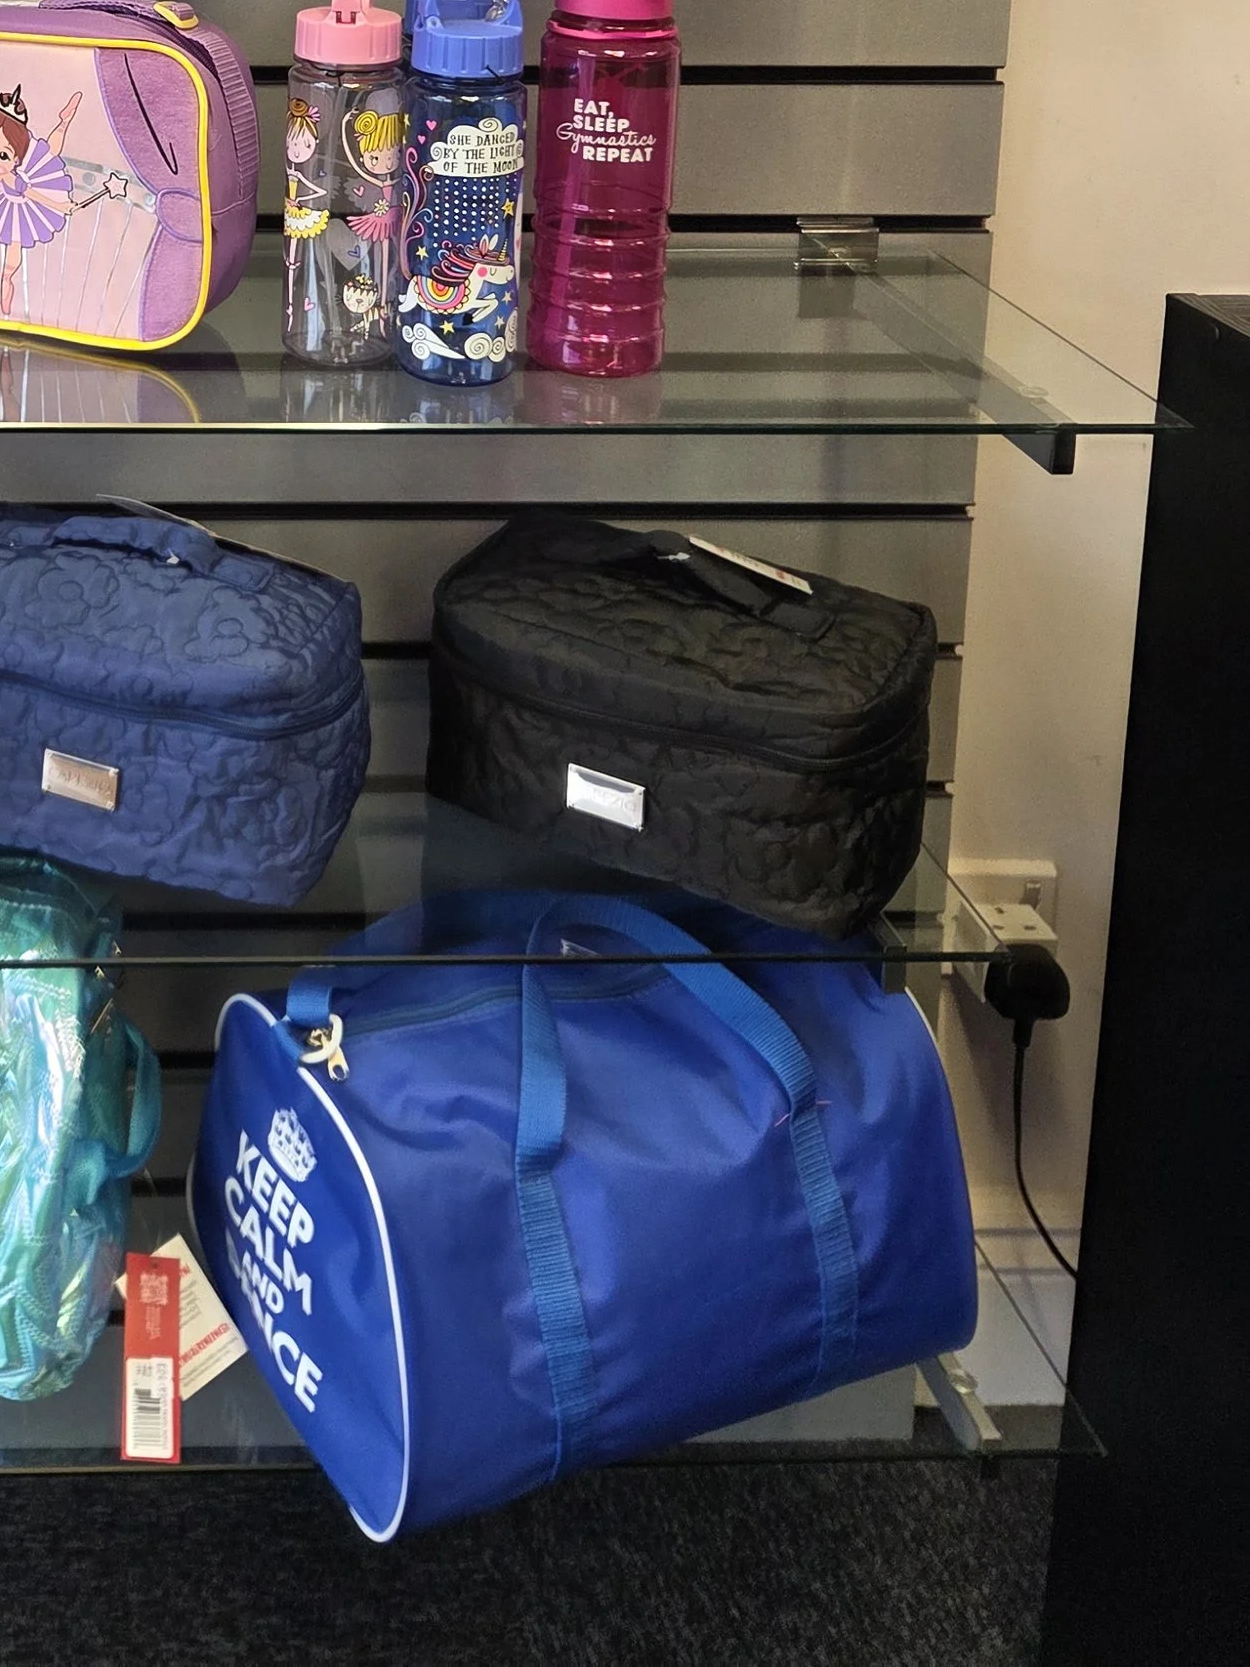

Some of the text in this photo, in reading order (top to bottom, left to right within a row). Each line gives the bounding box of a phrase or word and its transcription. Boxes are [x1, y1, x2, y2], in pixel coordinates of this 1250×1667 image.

[573, 98, 615, 119] EAT,
[572, 114, 630, 133] SLEEP
[449, 131, 516, 147] SHE DANCED
[556, 122, 657, 154] Gymnastics
[443, 144, 516, 160] BY THE LIGHT
[582, 146, 654, 163] REPEAT
[443, 159, 519, 174] OF THE MOON
[235, 1128, 315, 1248] KEEP
[224, 1175, 313, 1316] CALM
